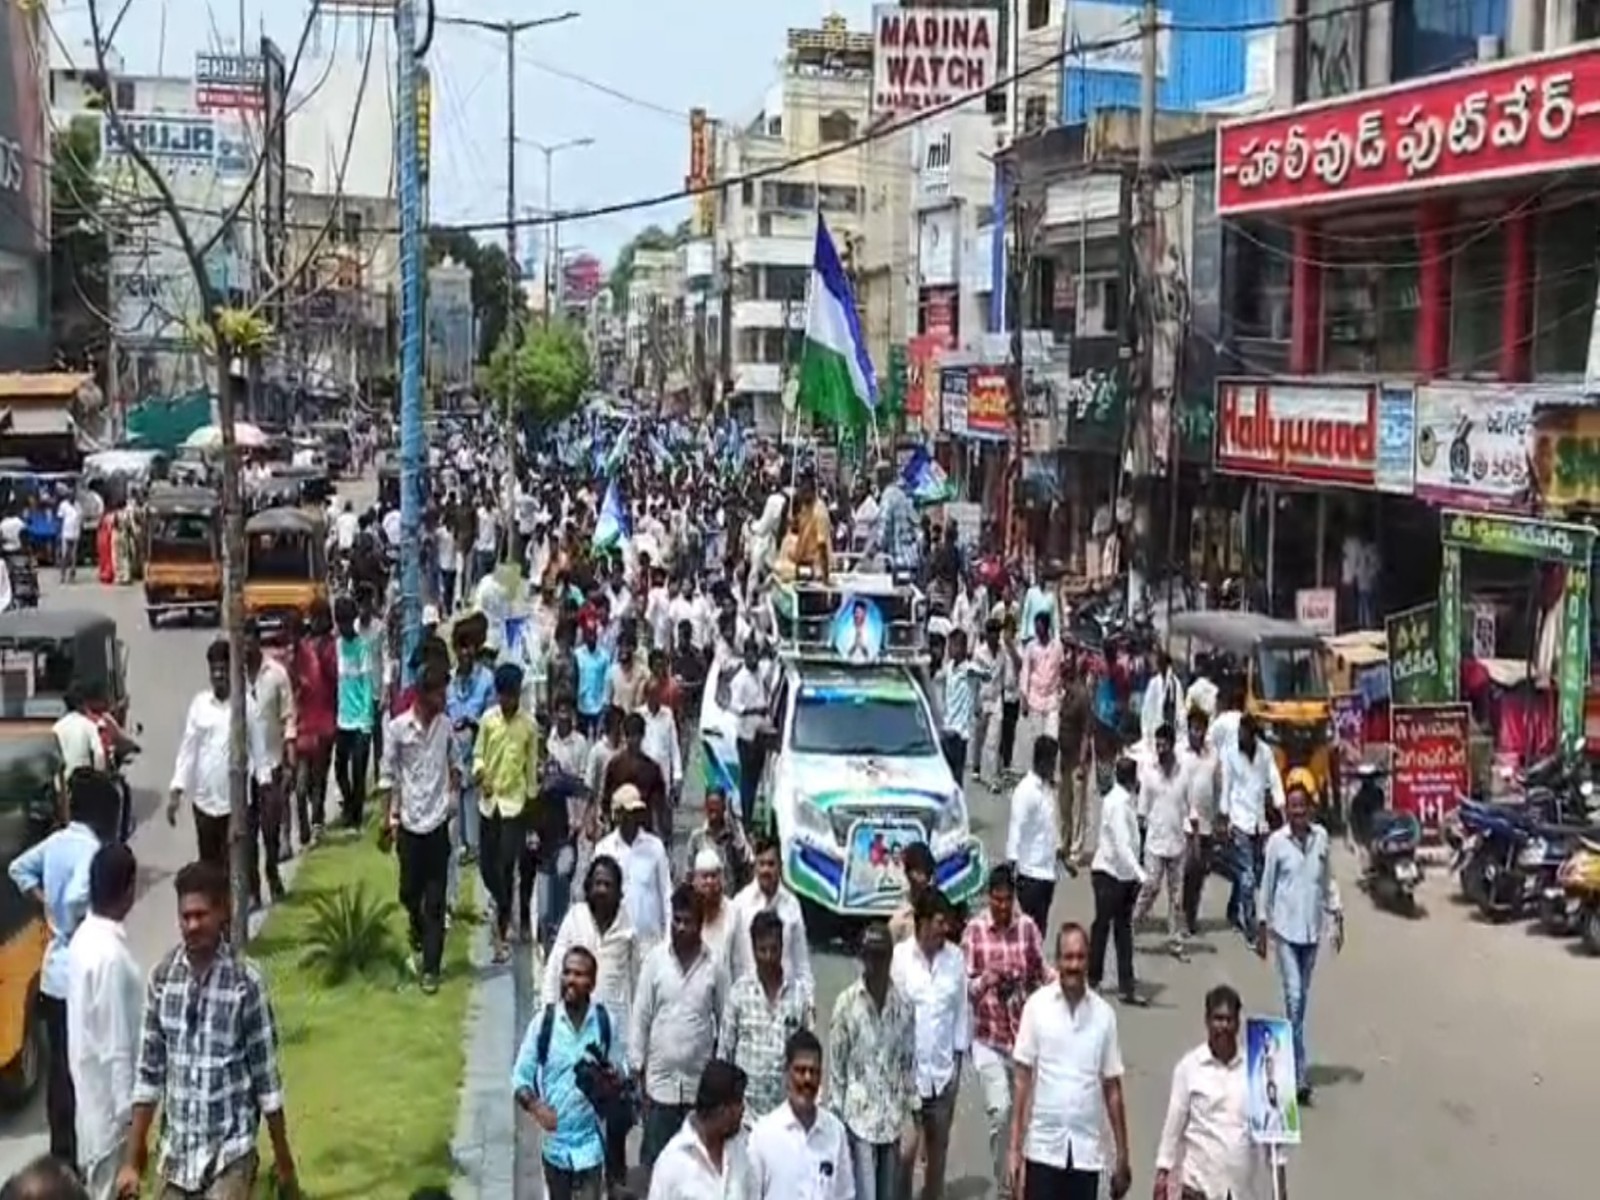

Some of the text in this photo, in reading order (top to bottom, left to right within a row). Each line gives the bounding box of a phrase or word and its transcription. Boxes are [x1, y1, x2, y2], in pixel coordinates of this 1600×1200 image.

[880, 15, 990, 50] MADINA
[887, 56, 985, 90] WATCH
[1238, 110, 1387, 187] హాలీవుడ్
